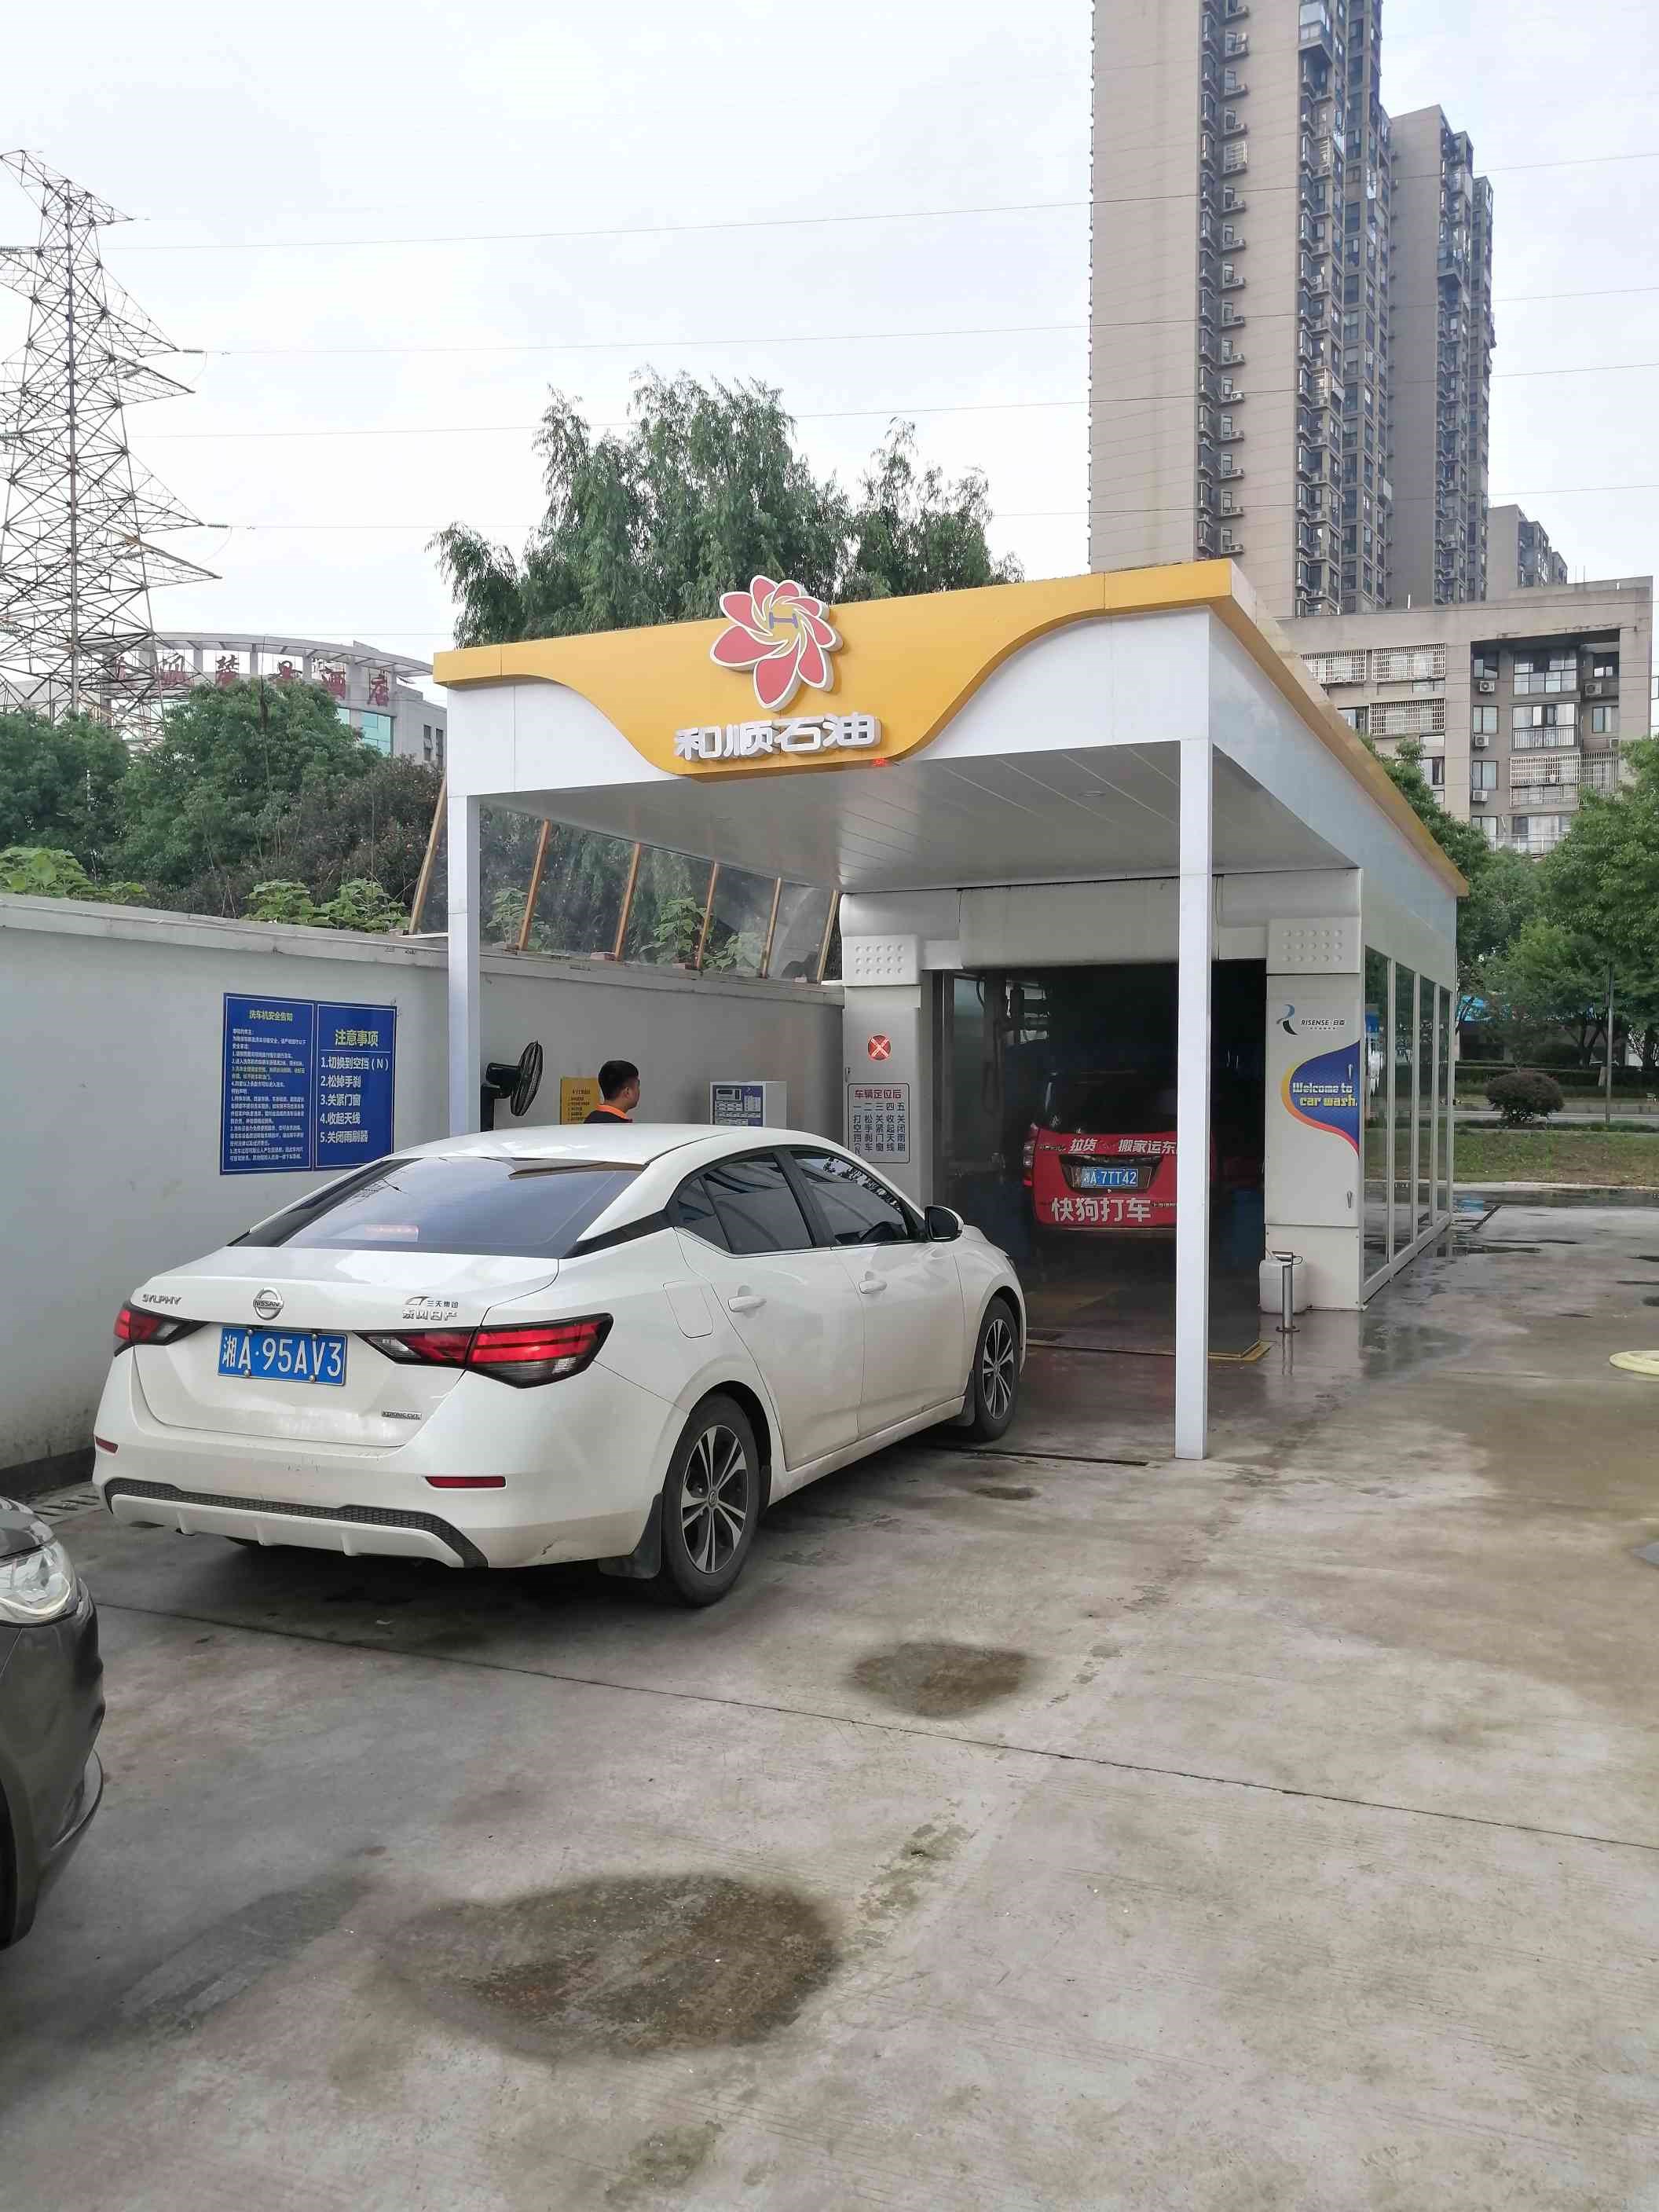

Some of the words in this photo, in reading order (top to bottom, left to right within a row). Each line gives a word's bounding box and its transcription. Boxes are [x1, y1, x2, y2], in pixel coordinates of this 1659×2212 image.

[674, 712, 881, 761] 和顺石油
[335, 1030, 379, 1047] 注意事项
[320, 1075, 361, 1088] 2.松掉手刹
[1292, 1082, 1339, 1093] Welcome
[1341, 1082, 1353, 1093] to
[320, 1094, 361, 1107] 3.关紧门窗
[855, 1089, 902, 1099] 车辆定位后
[1299, 1097, 1320, 1106] car
[320, 1112, 361, 1125] 4.收起天线
[320, 1130, 368, 1144] 5.关闭雨刷器
[1068, 1138, 1098, 1154] 拉货
[1051, 1197, 1152, 1222] 快狗打车
[142, 1294, 181, 1305] SYLPHY
[222, 1335, 342, 1377] 湘A·95AV3
